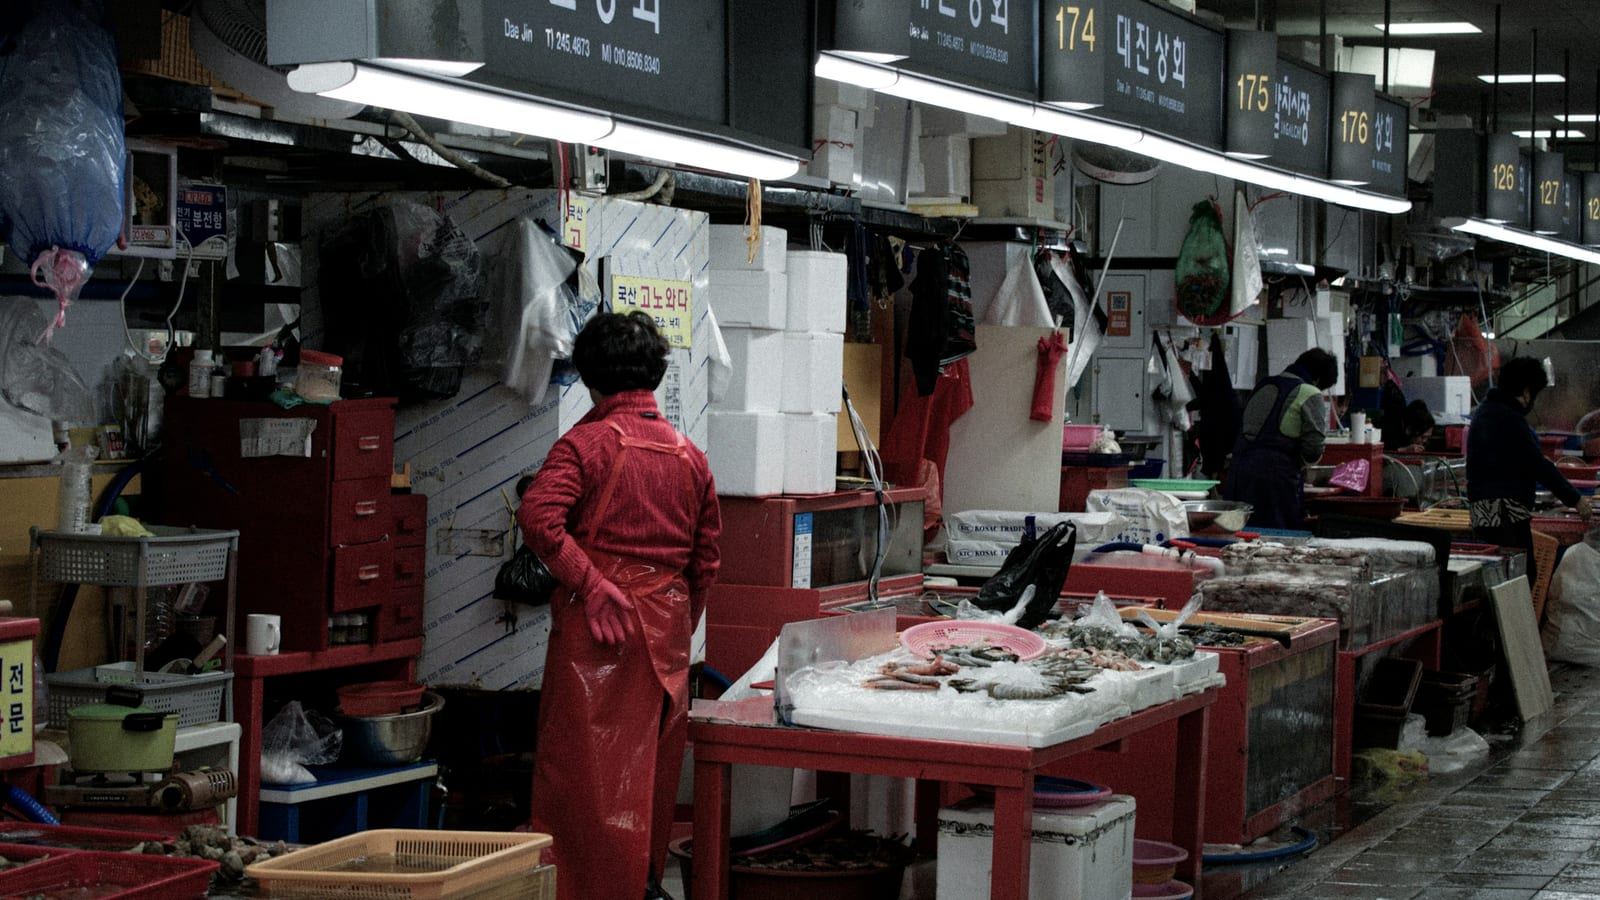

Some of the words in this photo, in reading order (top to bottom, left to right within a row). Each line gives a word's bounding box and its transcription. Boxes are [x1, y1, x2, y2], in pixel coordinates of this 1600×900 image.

[504, 18, 520, 39] Dae
[521, 23, 533, 43] Jin
[556, 31, 591, 58] 245.4873
[1055, 6, 1096, 52] 174
[1116, 14, 1186, 89] 대진상회
[1237, 73, 1269, 112] 175
[1341, 110, 1368, 145] 176
[1493, 163, 1514, 191] 126
[1540, 180, 1559, 205] 127
[192, 209, 223, 230] 분전함
[1588, 197, 1600, 220] 12
[570, 228, 581, 248] 고
[618, 286, 637, 305] 국산
[640, 286, 688, 312] 고노와다
[9, 663, 24, 733] 전문
